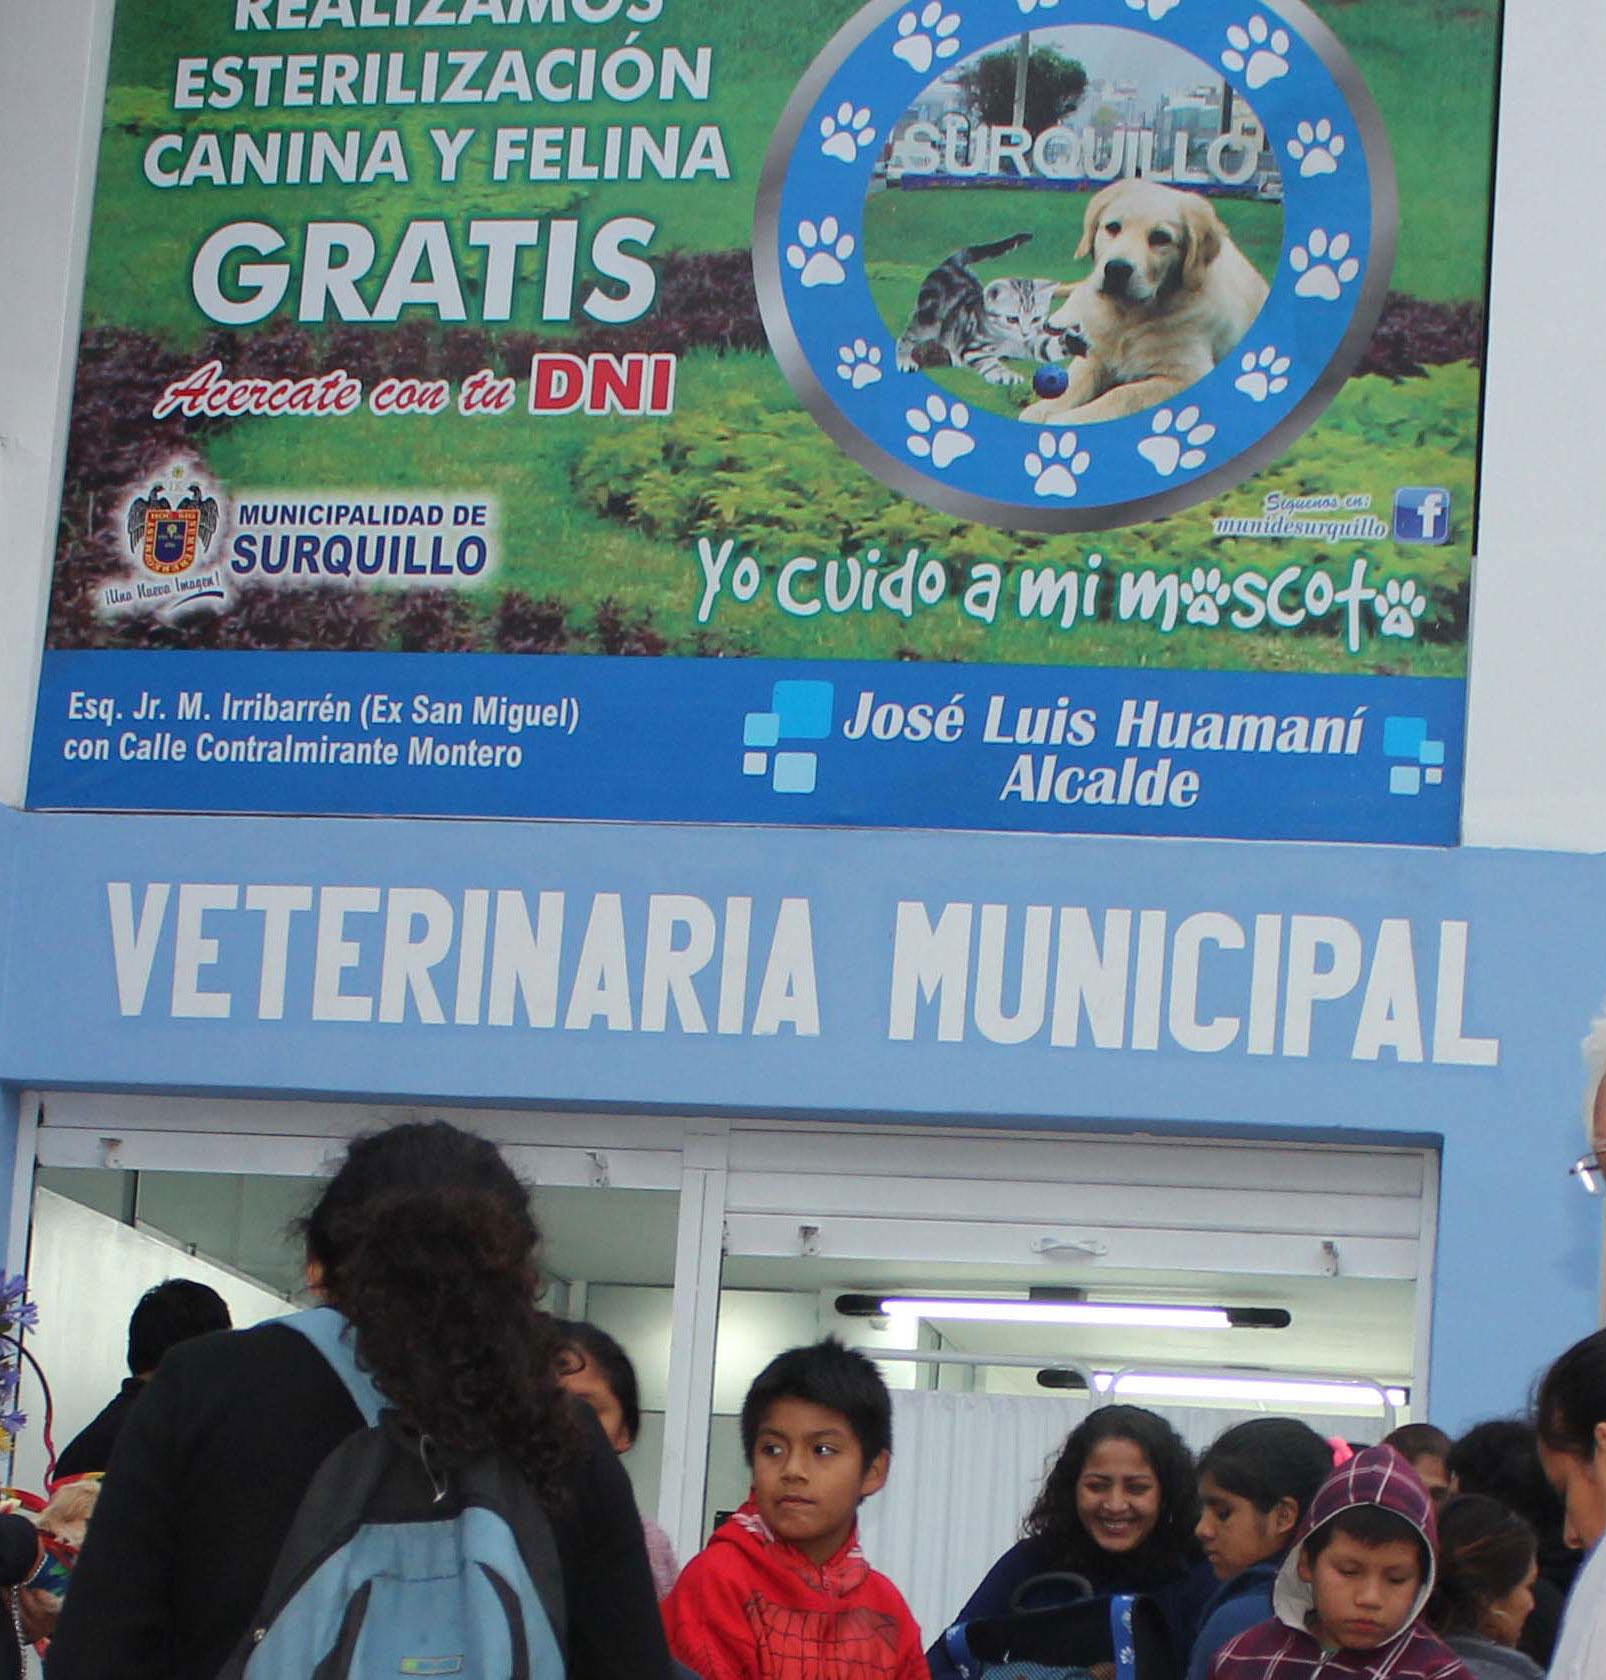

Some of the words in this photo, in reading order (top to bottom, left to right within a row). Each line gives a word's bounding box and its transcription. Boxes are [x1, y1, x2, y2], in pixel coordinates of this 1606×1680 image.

[173, 31, 713, 110] ESTERILIZACIÓN
[143, 129, 409, 188] CANINA
[430, 128, 477, 183] Y
[494, 125, 732, 183] FELINA
[898, 122, 1259, 184] SURQUILLO
[192, 216, 659, 325] GRATIS
[155, 360, 361, 419] Acercate
[369, 377, 451, 417] con
[459, 368, 516, 416] tu
[529, 353, 678, 416] DNI
[238, 503, 447, 526] MUNICIPALIDAD
[453, 504, 487, 526] DE
[1215, 515, 1389, 542] munidesurquillo
[231, 533, 488, 577] SURQUILLO
[697, 537, 760, 623] Yo
[777, 548, 946, 617] cuido
[963, 563, 1002, 623] a
[1018, 552, 1102, 629] mi
[68, 691, 122, 727] Esq.
[133, 692, 166, 721] Jr.
[178, 693, 211, 721] M.
[222, 692, 351, 723] Irribarrén
[360, 694, 403, 730] (Ex
[412, 695, 463, 725] San
[472, 696, 580, 735] Miguel)
[843, 691, 966, 742] José
[982, 694, 1097, 748] Luis
[1115, 699, 1369, 755] Huamaní
[64, 737, 109, 761] con
[118, 731, 187, 762] Calle
[196, 732, 398, 765] Contralmirante
[408, 737, 523, 768] Montero
[999, 752, 1201, 808] Alcalde
[106, 881, 819, 1038] VETERINARIA
[888, 900, 1501, 1068] MUNICIPAL
